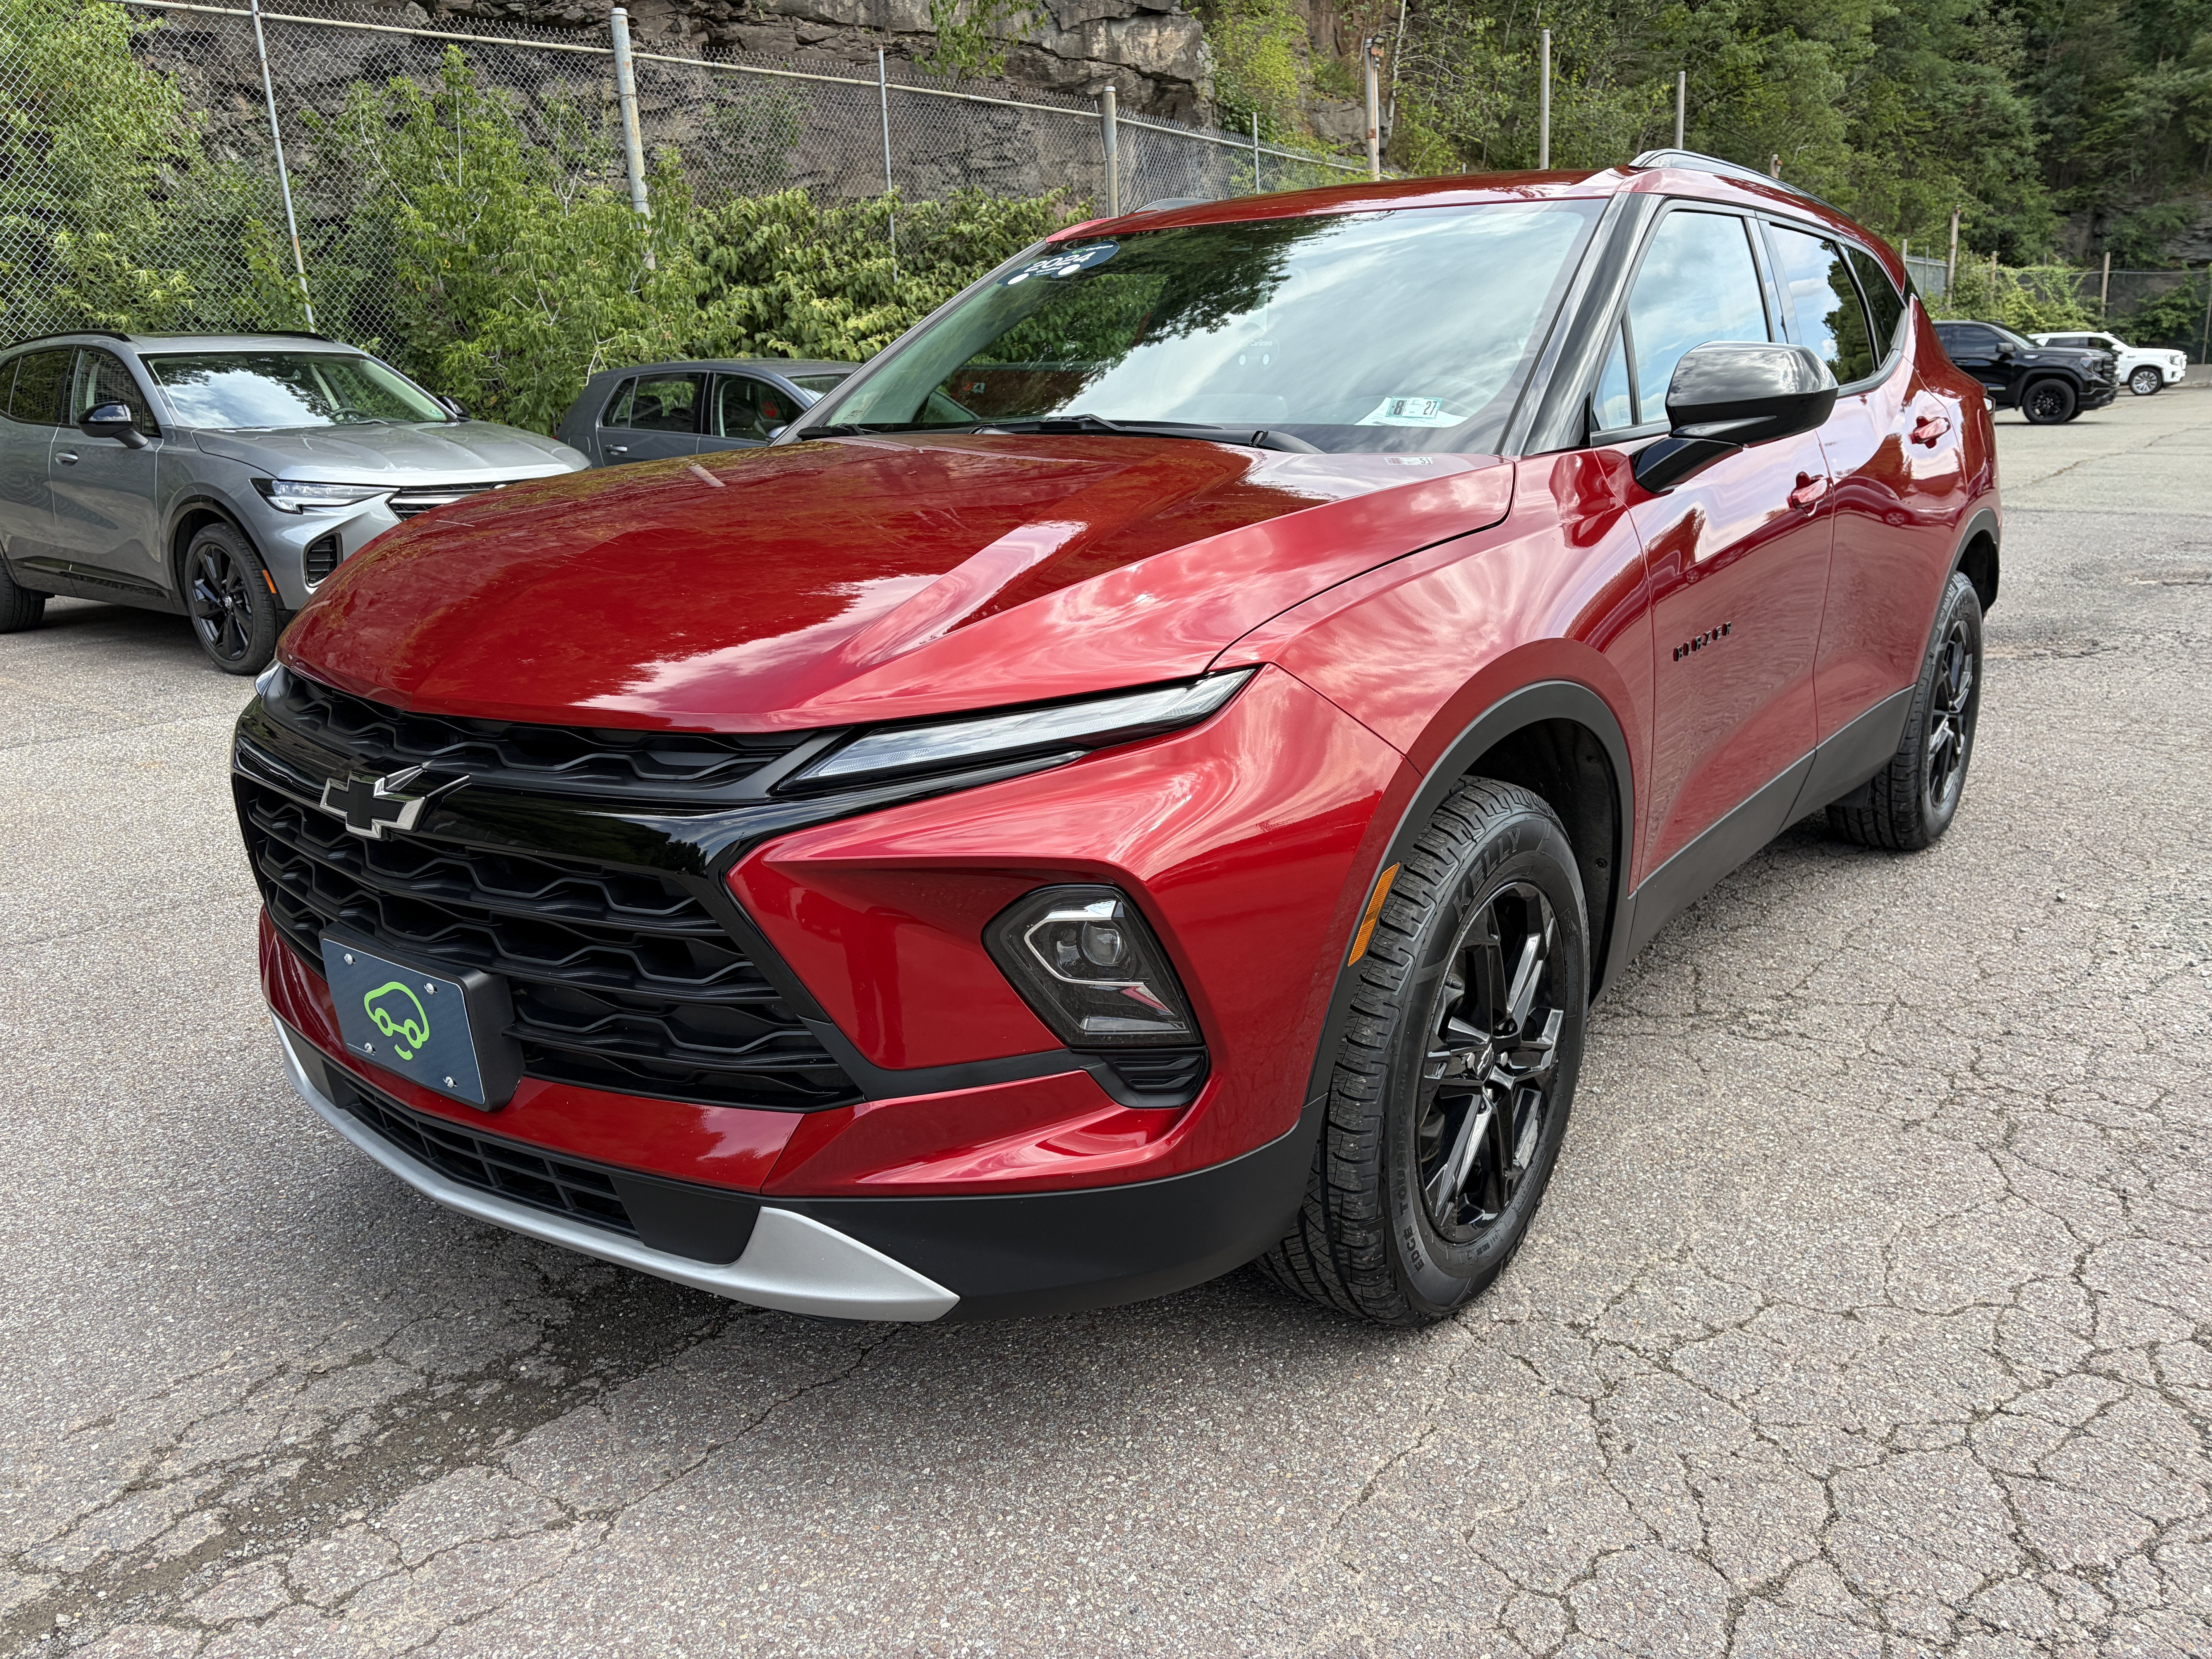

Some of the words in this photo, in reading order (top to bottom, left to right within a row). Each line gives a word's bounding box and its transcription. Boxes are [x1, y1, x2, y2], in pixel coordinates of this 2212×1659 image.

[1024, 251, 1097, 273] 2024
[1393, 400, 1405, 415] 8
[1423, 401, 1439, 416] 27
[1673, 621, 1732, 662] BLAZER
[1453, 827, 1521, 923] KELLY
[1403, 1224, 1425, 1272] EDGE
